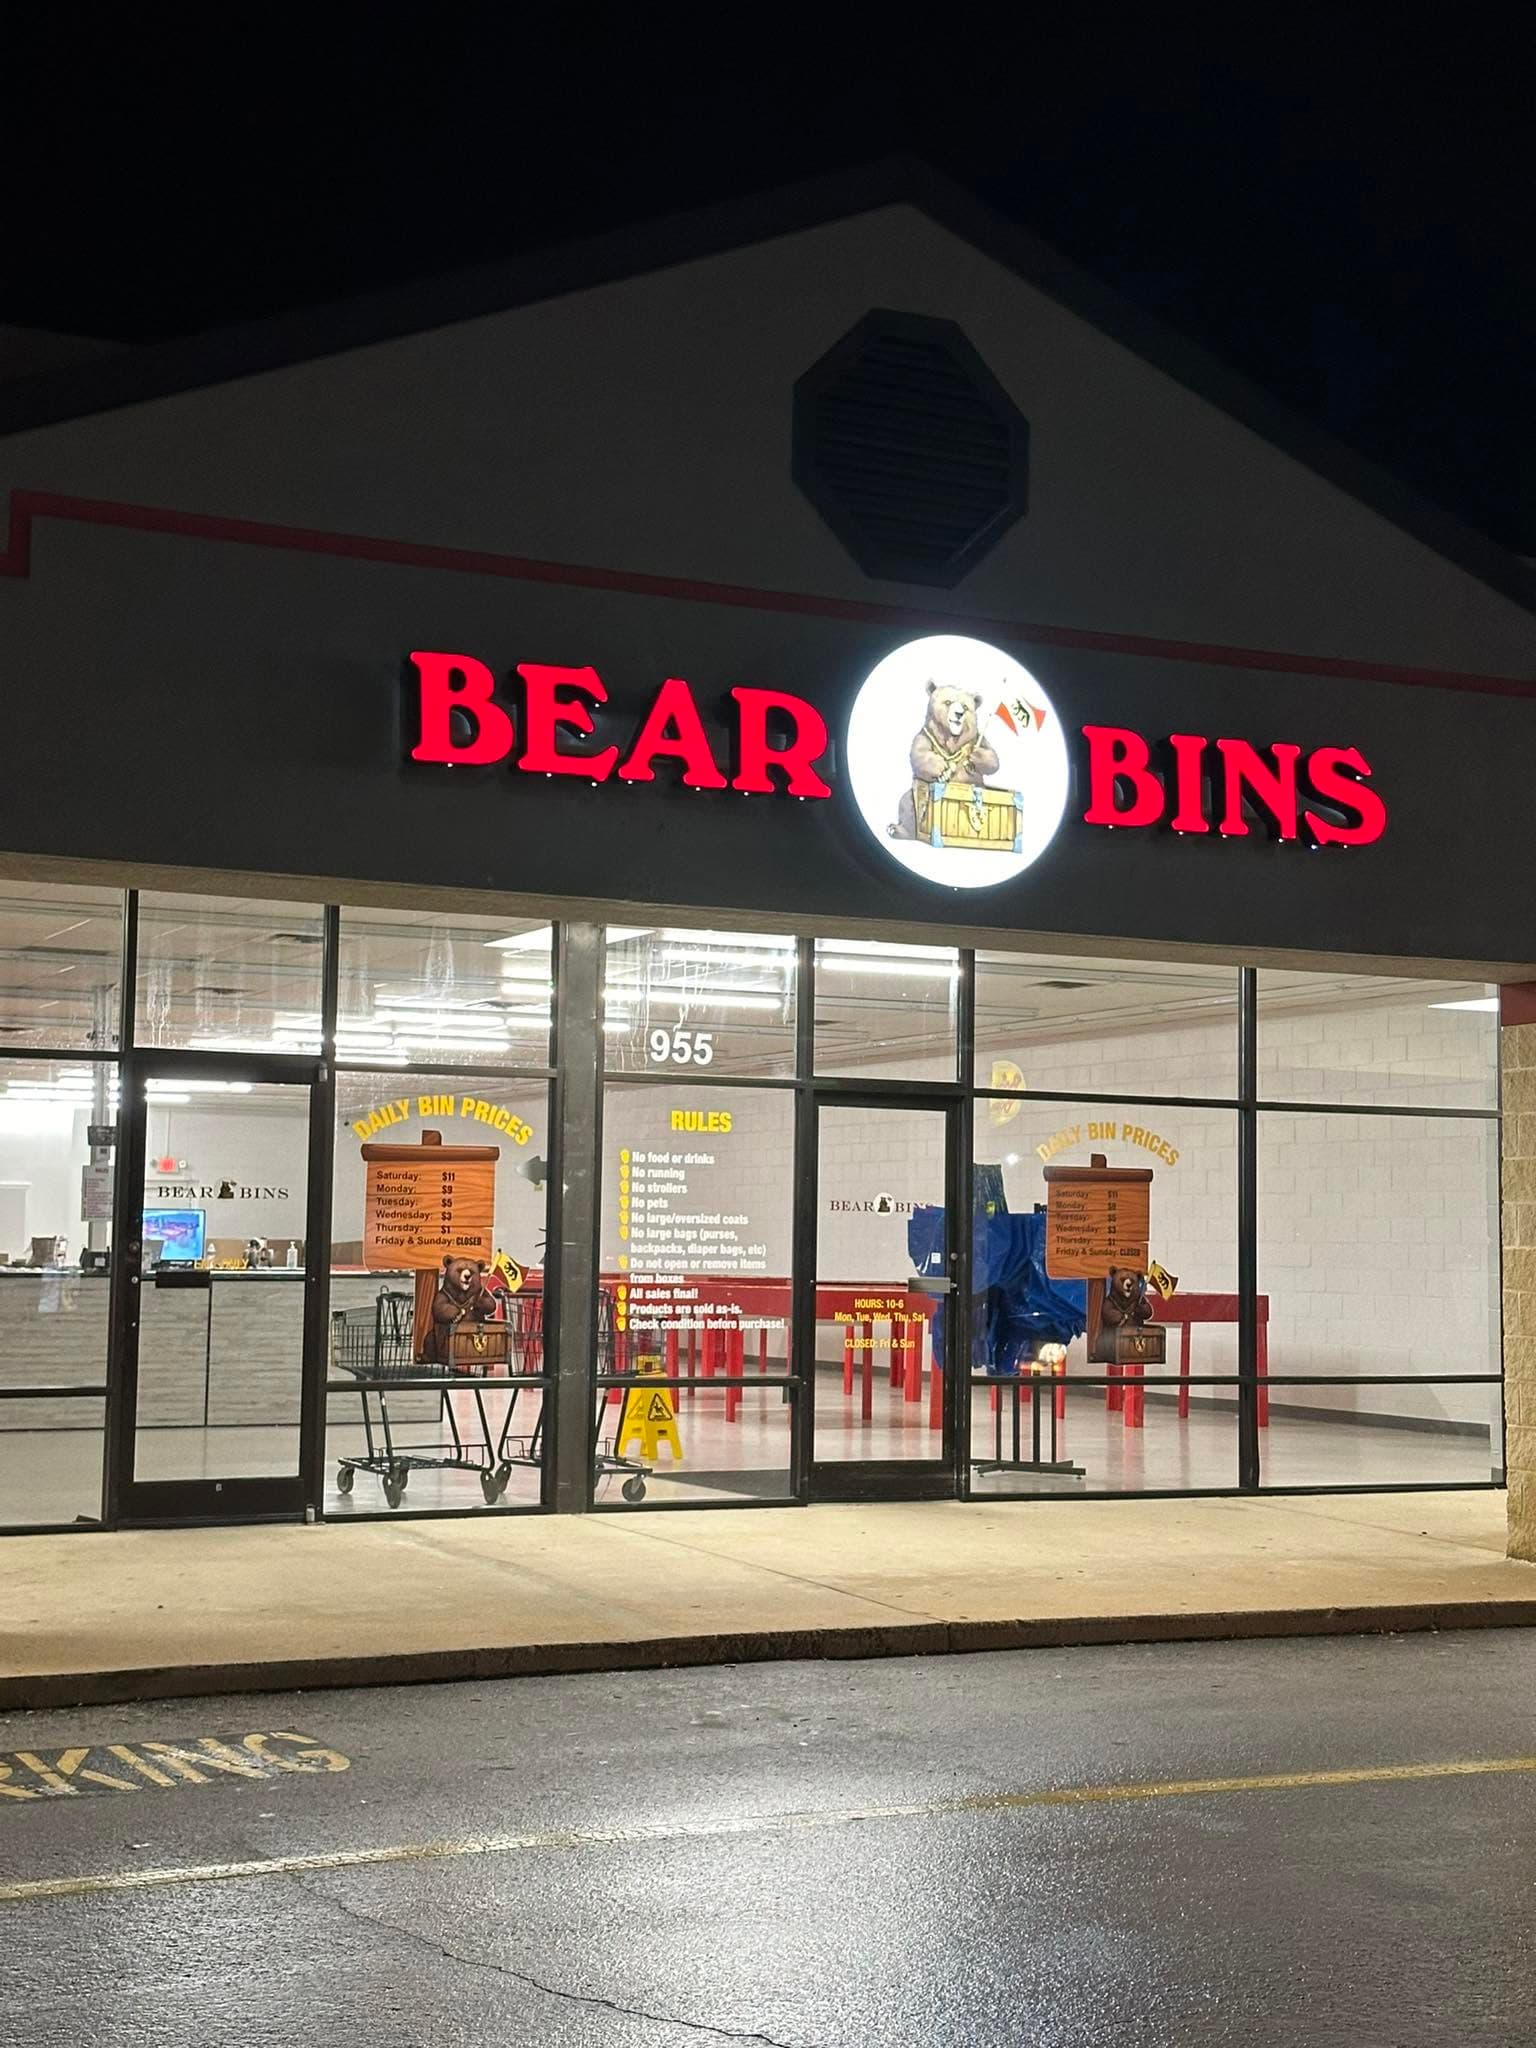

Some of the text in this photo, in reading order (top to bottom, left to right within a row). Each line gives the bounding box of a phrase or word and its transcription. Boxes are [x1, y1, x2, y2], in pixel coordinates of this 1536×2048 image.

[410, 651, 1387, 848] BEAR BINS
[650, 1029, 713, 1065] 955
[352, 1094, 534, 1146] DAILY BIN PRICES
[671, 1110, 732, 1133] RULES
[1036, 1122, 1180, 1167] DAILY BIN PRICES
[632, 1151, 715, 1164] No food or drinks
[376, 1170, 455, 1182] Saturday: $11
[632, 1166, 685, 1181] No running
[158, 1185, 289, 1200] BEAR BINS
[376, 1184, 453, 1195] Monday: $9
[632, 1181, 688, 1194] No strollers
[376, 1197, 452, 1208] Tuesday: $5
[631, 1196, 668, 1210] No pets
[830, 1200, 874, 1213] BEAR
[376, 1210, 452, 1221] Wednesday: $3
[631, 1212, 749, 1226] No large/oversized coats
[376, 1222, 451, 1234] Thursday: $1
[631, 1227, 738, 1241] No large bags (purses,
[375, 1236, 482, 1247] Friday & Sunday: CLOSED
[630, 1242, 767, 1256] backpacks, diaper bags, etc)
[1056, 1247, 1080, 1256] Friday
[630, 1258, 766, 1271] Do not open or remove items
[630, 1273, 684, 1284] from boxes
[630, 1287, 698, 1299] All sales final!
[629, 1303, 742, 1314] Products are sold as-is.
[854, 1298, 904, 1309] HOURS: 10-6
[629, 1318, 785, 1330] Check condition before purchase!
[834, 1312, 854, 1323] Mon,
[855, 1312, 872, 1323] Tue,
[844, 1338, 915, 1348] CLOSED: Fri & Sun
